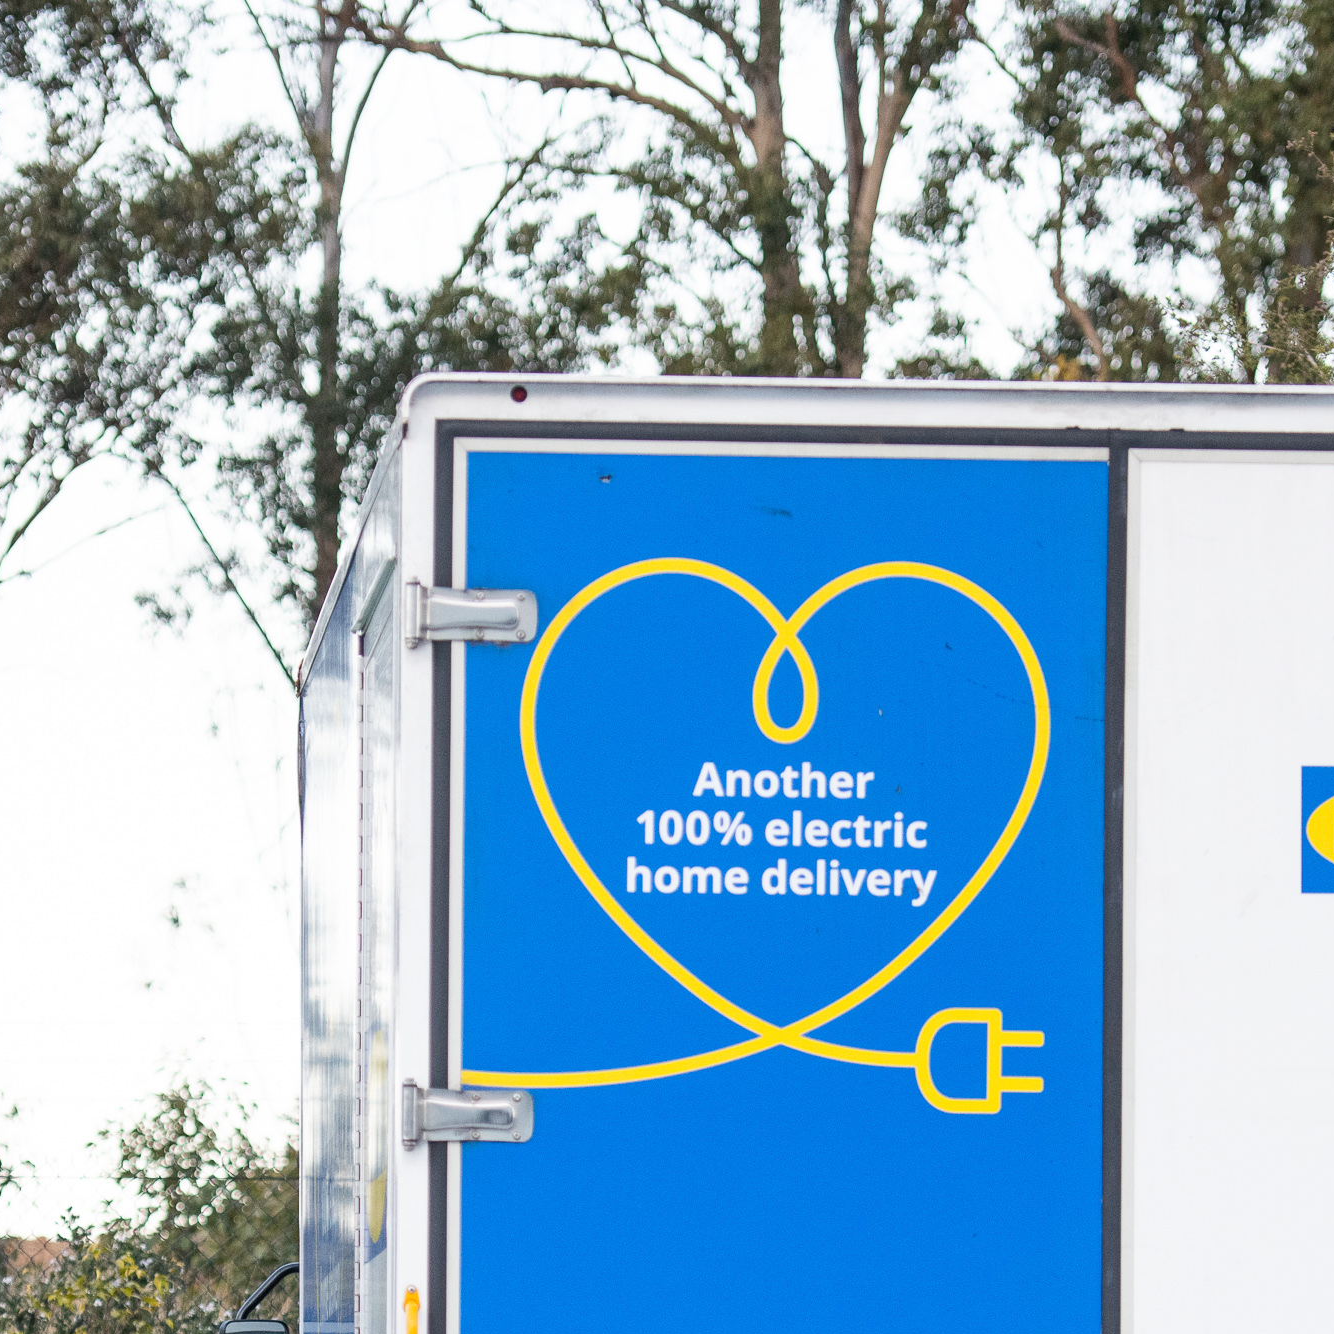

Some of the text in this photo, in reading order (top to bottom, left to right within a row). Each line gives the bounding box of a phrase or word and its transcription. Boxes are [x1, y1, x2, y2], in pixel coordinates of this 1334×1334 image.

[693, 762, 874, 799] Another
[635, 809, 928, 849] 100% electric
[626, 857, 937, 907] home delivery
